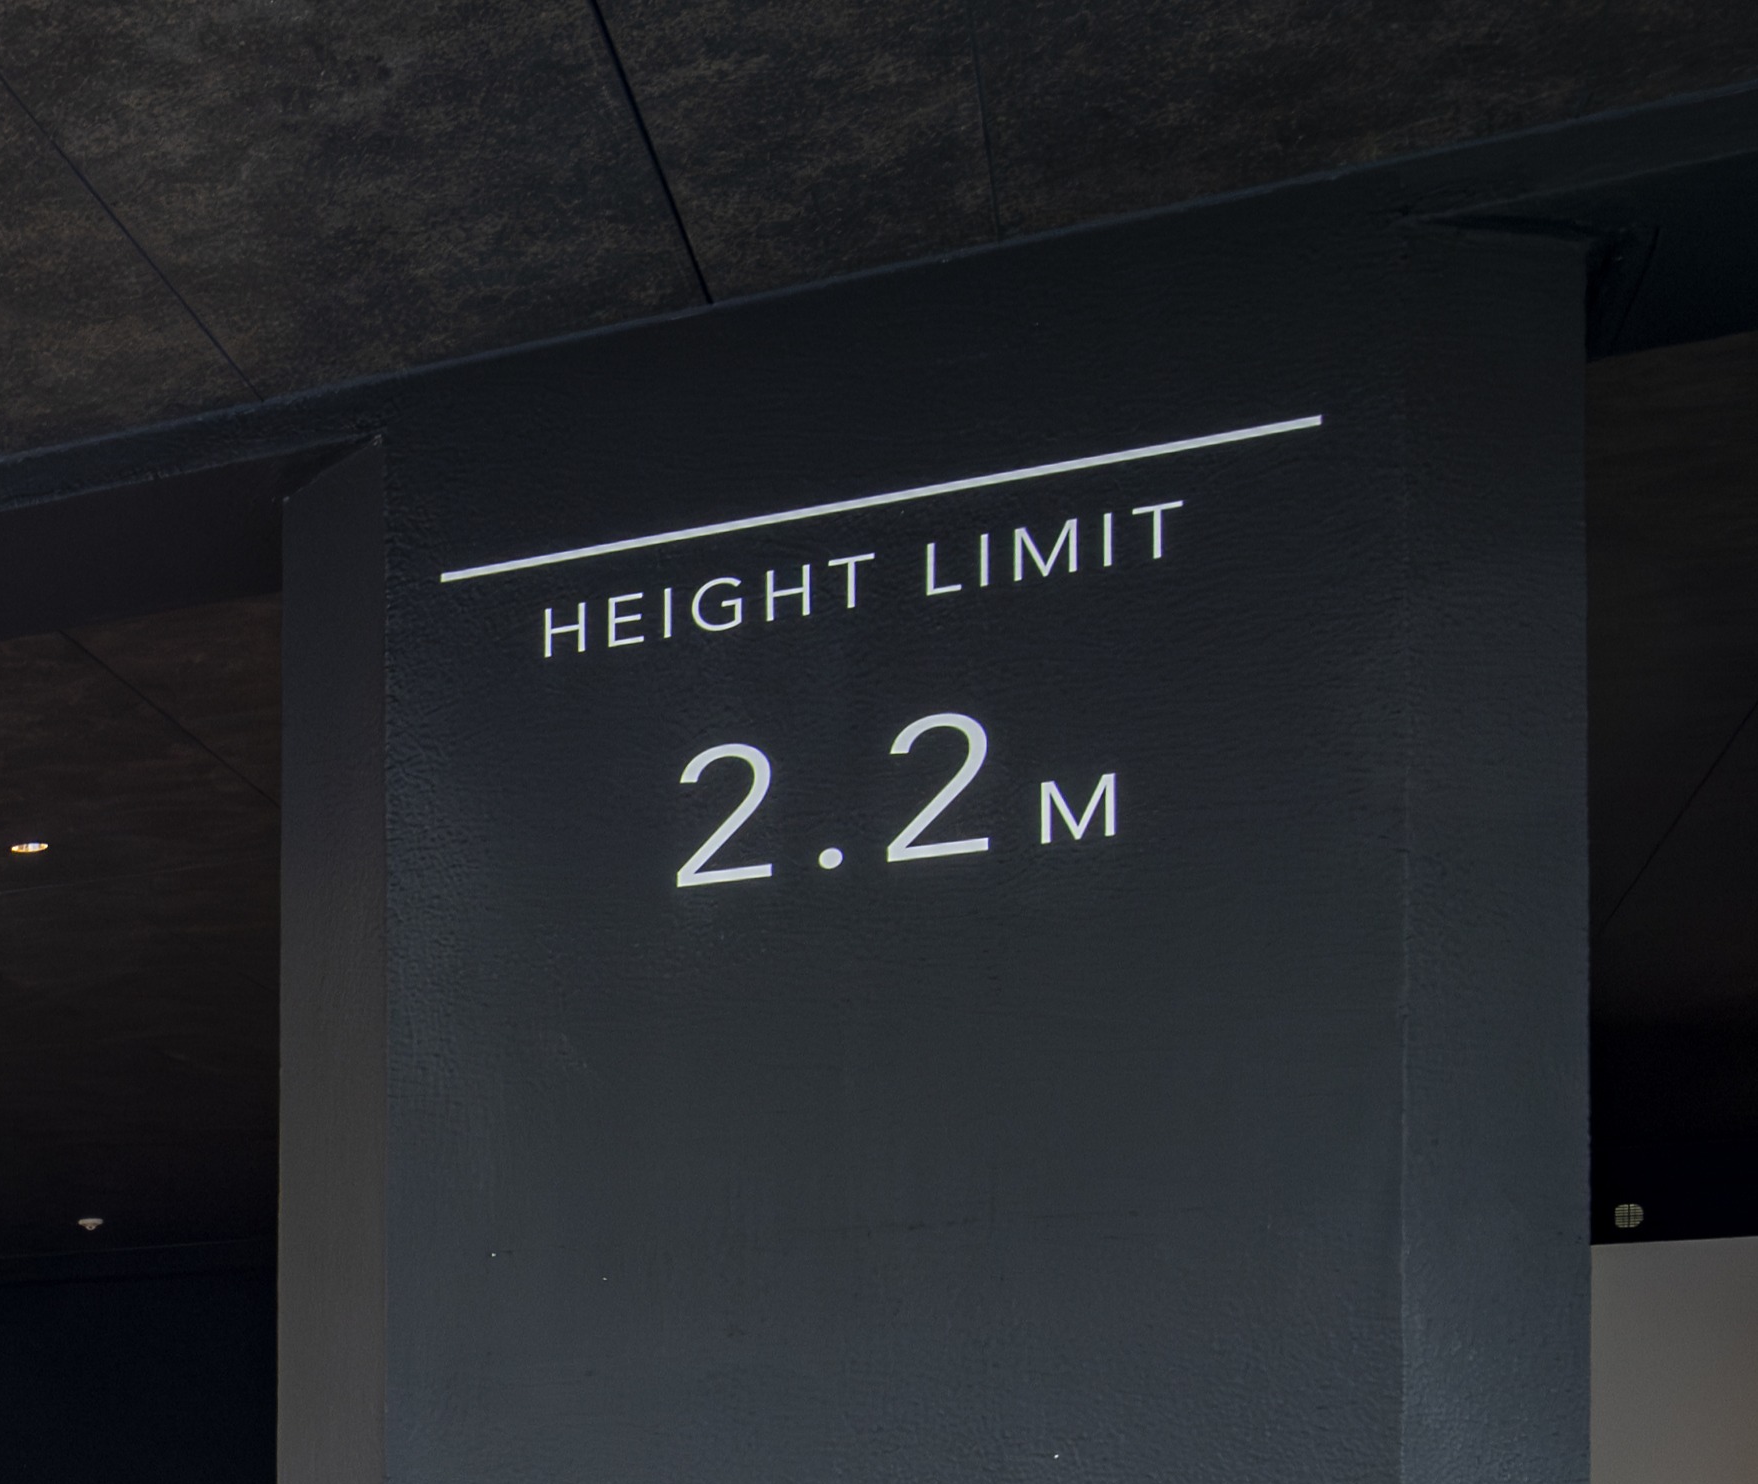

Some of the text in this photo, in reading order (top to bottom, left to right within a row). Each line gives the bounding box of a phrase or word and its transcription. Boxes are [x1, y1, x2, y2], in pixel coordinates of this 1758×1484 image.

[542, 499, 1185, 658] HEIGHT LIMIT
[676, 712, 1117, 888] 2.2 M
